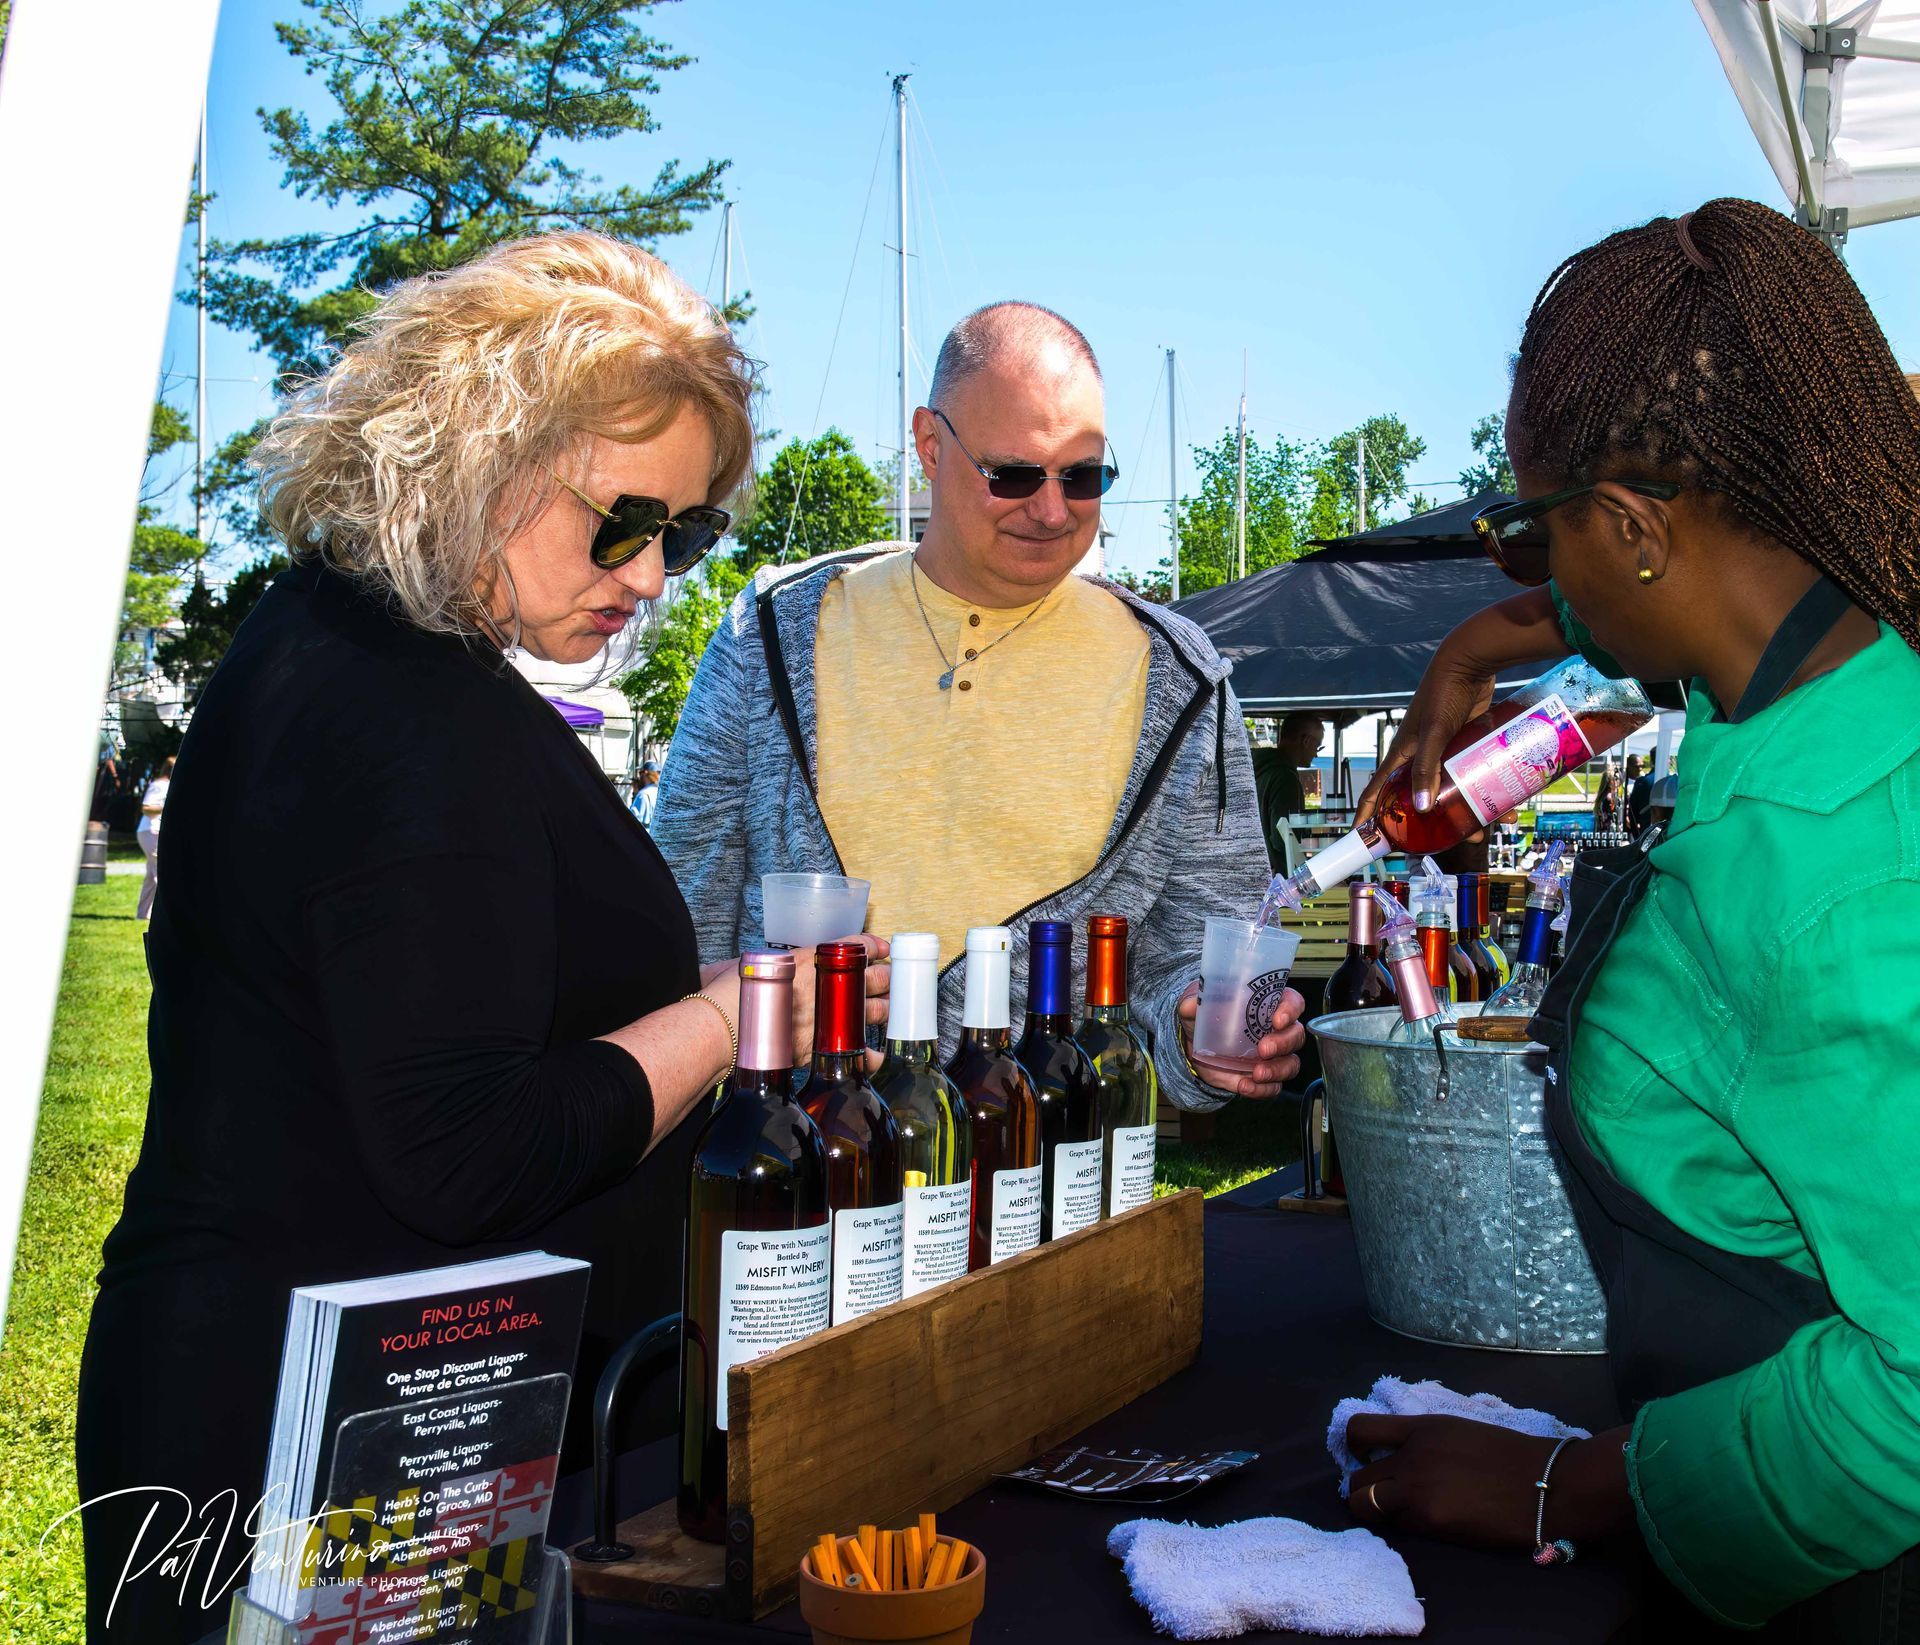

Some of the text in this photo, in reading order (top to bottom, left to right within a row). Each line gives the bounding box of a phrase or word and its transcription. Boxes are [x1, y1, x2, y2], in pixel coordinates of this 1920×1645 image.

[1253, 973, 1279, 989] LOCK
[1252, 987, 1271, 1006] CRAFT
[1069, 1150, 1084, 1158] Grape
[1131, 1151, 1151, 1161] MISFIT
[1076, 1167, 1098, 1179] MISFIT
[1001, 1178, 1017, 1187] Grape
[920, 1192, 938, 1201] Grape
[940, 1191, 952, 1200] Wine
[1009, 1196, 1033, 1208] MISFIT
[853, 1220, 872, 1230] Grape
[873, 1218, 887, 1227] Wine
[928, 1209, 970, 1224] MISFIT WIN
[737, 1242, 759, 1253] Grape
[761, 1242, 779, 1250] Wine
[781, 1241, 796, 1249] with
[797, 1238, 818, 1247] Natural
[862, 1236, 903, 1253] MISFIT WIN
[777, 1251, 809, 1261] Bottled By
[747, 1259, 825, 1278] MISFIT WINERY
[783, 1281, 796, 1290] Road,
[421, 1296, 514, 1326] FIND US IN
[731, 1314, 748, 1322] grapes
[749, 1313, 762, 1321] from
[790, 1310, 803, 1318] world
[733, 1306, 765, 1315] Washington,
[381, 1313, 543, 1353] YOUR LOCAL AREA.
[763, 1335, 791, 1344] throughout
[784, 1327, 793, 1335] and
[386, 1352, 528, 1385] One Stop Discount Liquors-
[400, 1366, 513, 1397] Havre de Grace, MD
[403, 1399, 503, 1426] East Coast Liquors-
[414, 1413, 489, 1437] Perryville, MD
[399, 1442, 493, 1467] Perryville Liquors-
[407, 1454, 482, 1479] Perryville, MD
[385, 1479, 493, 1511] Herb's On The Curb-
[381, 1492, 493, 1526] Havre de Grace, MD
[423, 1529, 441, 1542] Hill
[443, 1522, 484, 1538] Liquors-
[391, 1537, 470, 1564] Aberdeen, MD
[432, 1564, 473, 1579] Liquors-
[384, 1576, 463, 1605] Aberdeen, MD
[370, 1603, 468, 1634] Aberdeen Liquors-
[377, 1616, 456, 1645] Aberdeen, MD
